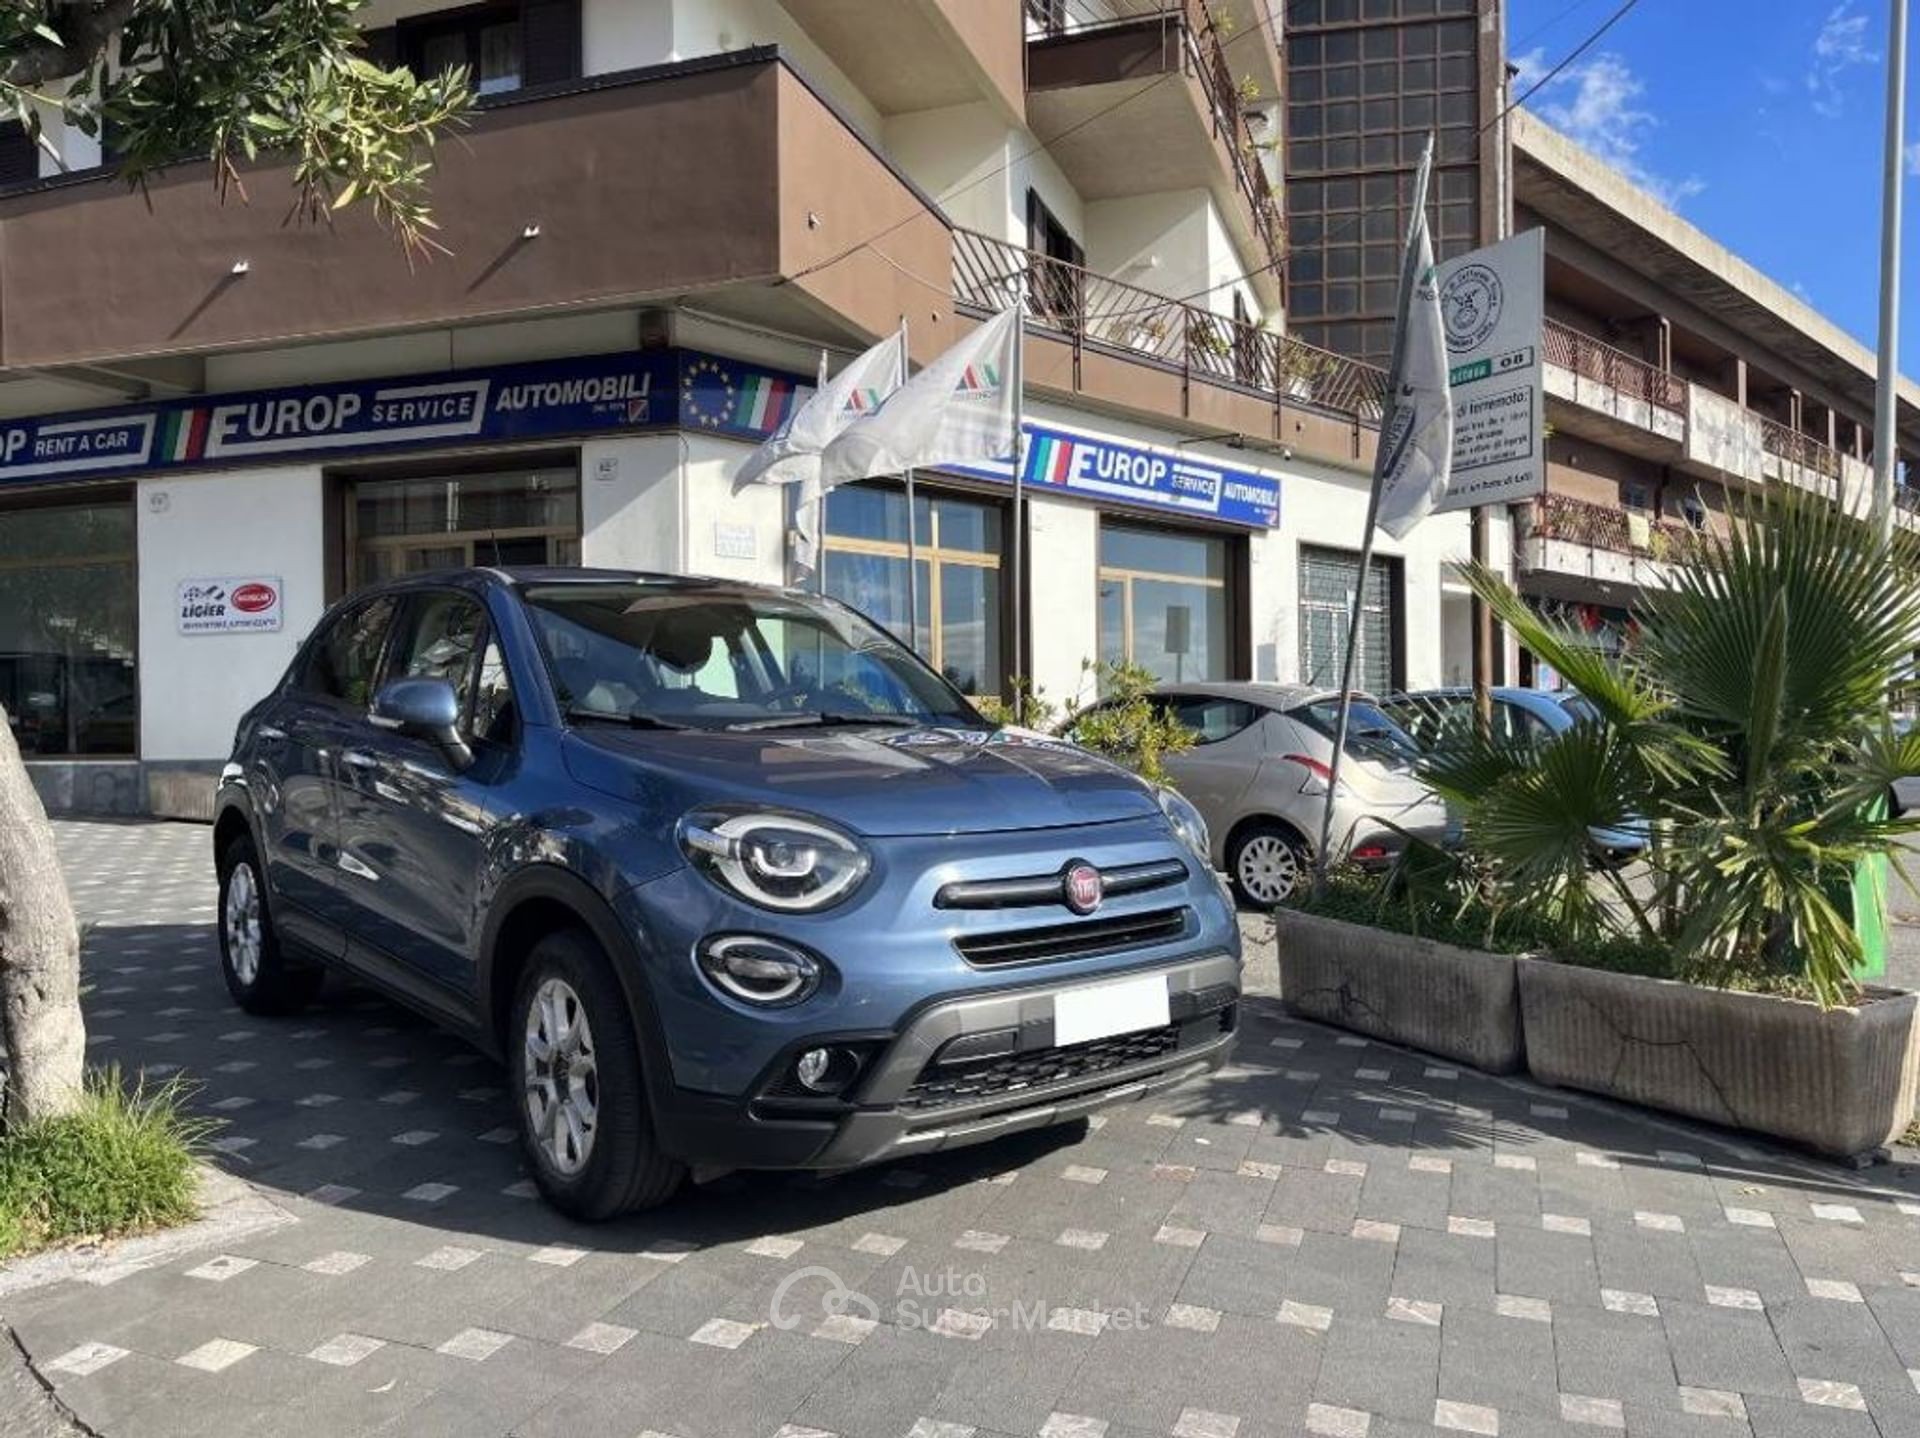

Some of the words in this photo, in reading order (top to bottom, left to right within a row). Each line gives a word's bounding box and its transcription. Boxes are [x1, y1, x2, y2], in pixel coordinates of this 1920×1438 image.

[495, 372, 652, 412] AUTOMOBILI
[0, 429, 27, 462] P
[34, 437, 76, 457] RENT
[78, 435, 90, 451] A
[95, 431, 129, 449] CAR
[205, 393, 361, 459] EUROP
[372, 394, 472, 422] SERVICE
[1069, 445, 1167, 489] EUROP
[1171, 474, 1216, 495] SERVICE
[1224, 481, 1279, 507] AUTOMOBILI
